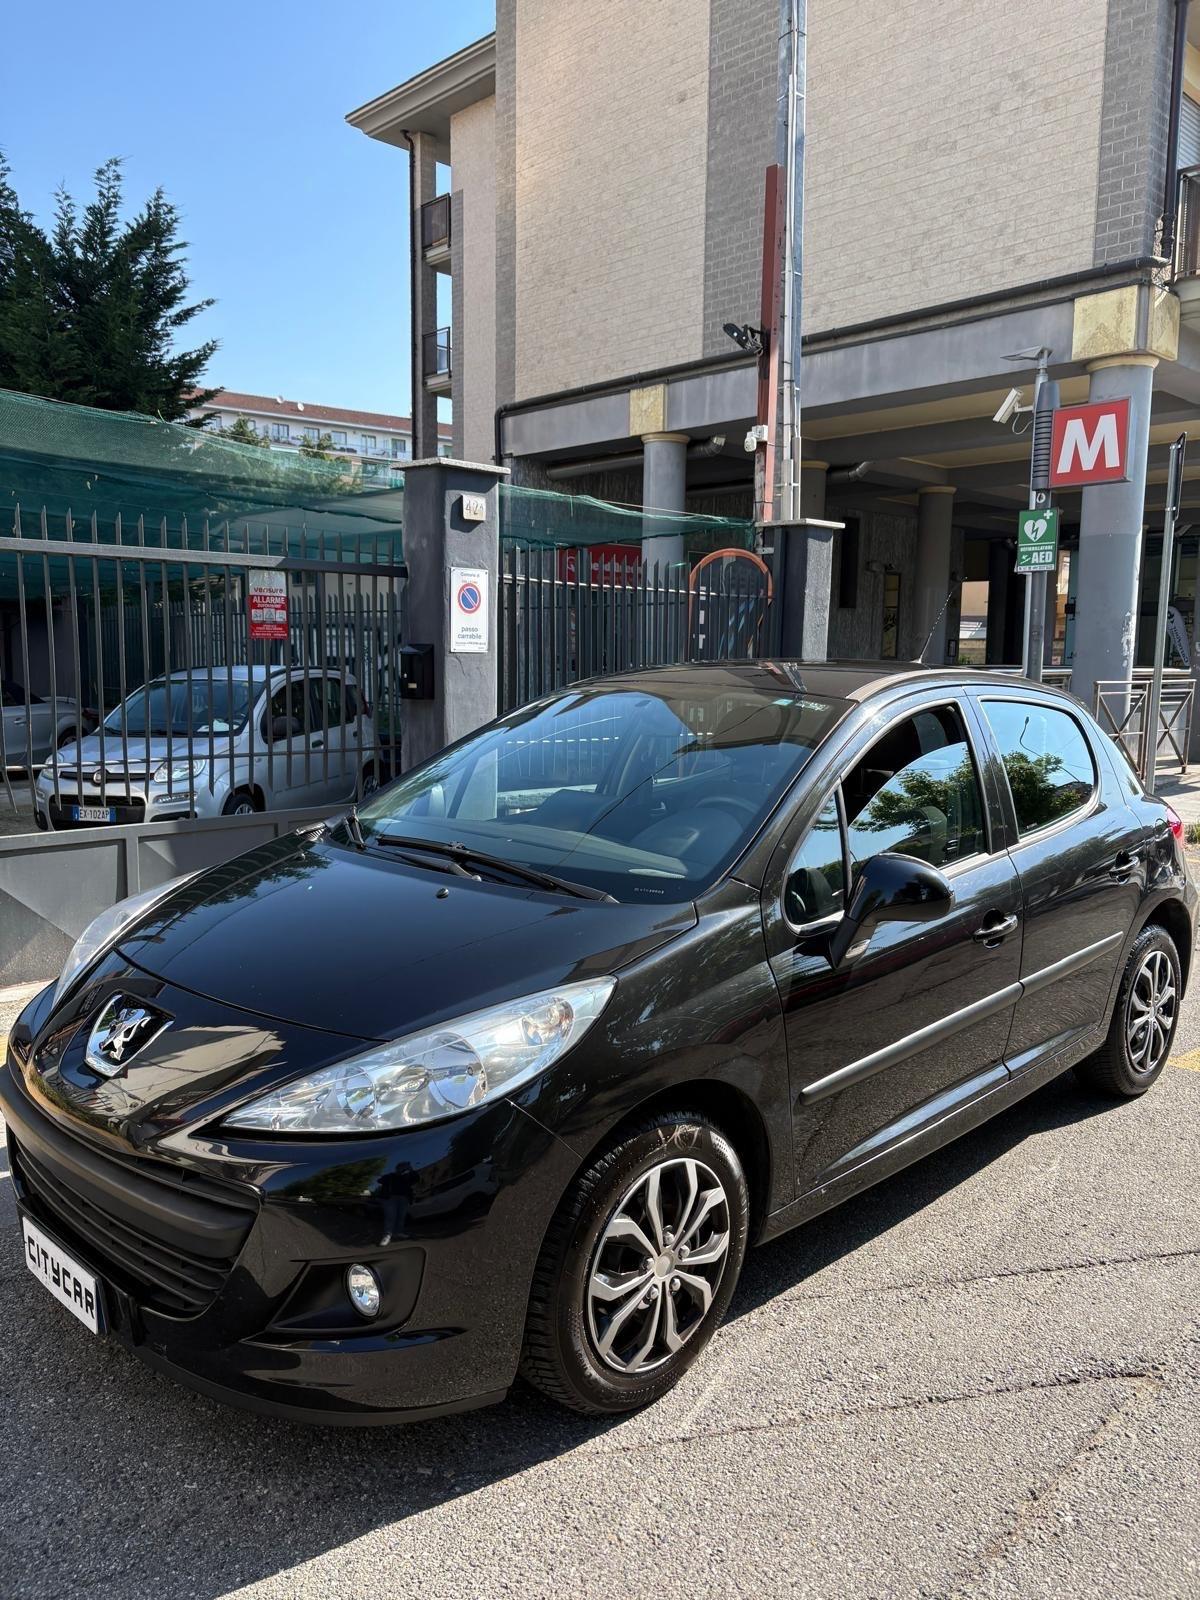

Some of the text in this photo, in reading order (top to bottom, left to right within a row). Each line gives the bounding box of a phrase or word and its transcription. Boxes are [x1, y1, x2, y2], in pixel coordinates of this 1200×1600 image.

[1057, 413, 1120, 474] M
[1031, 551, 1053, 563] AED
[457, 632, 482, 640] carrabile
[27, 1235, 95, 1319] CITYCAR
